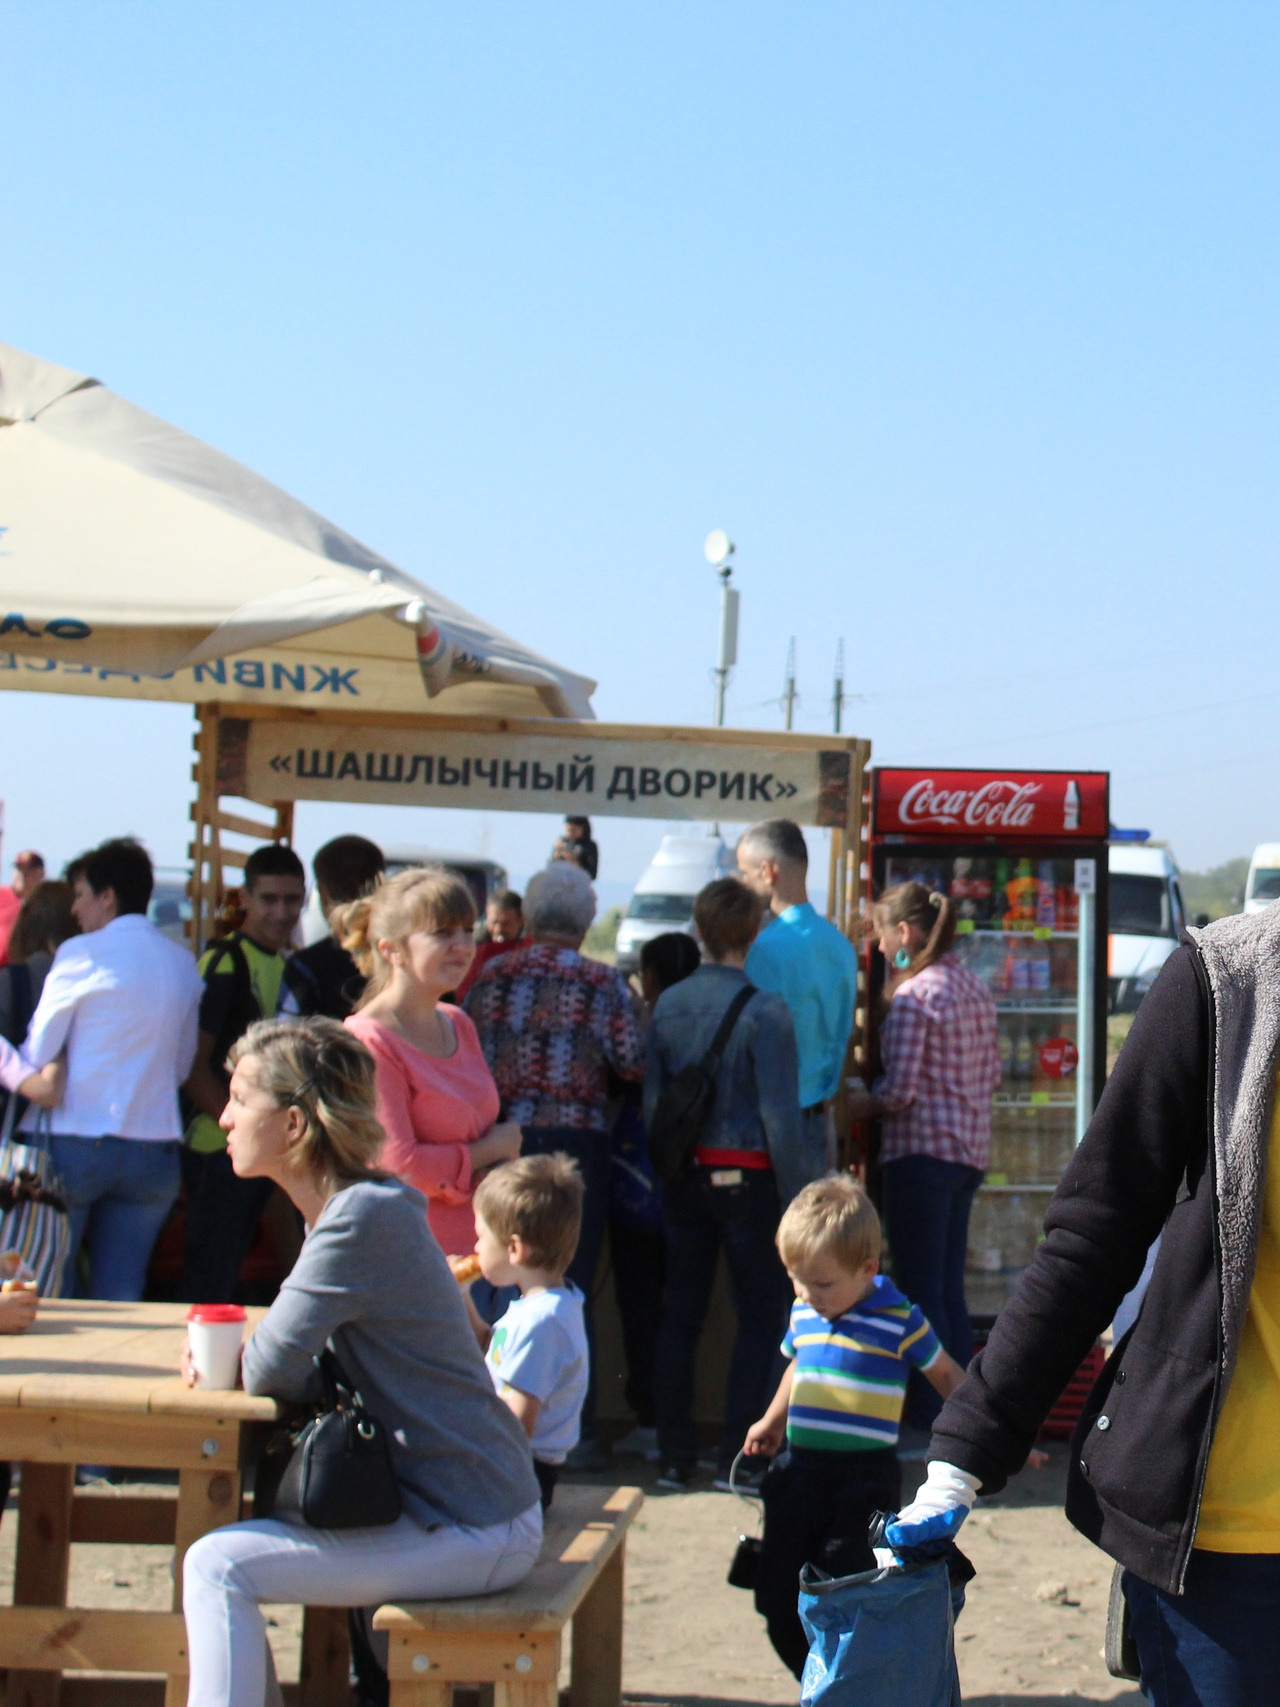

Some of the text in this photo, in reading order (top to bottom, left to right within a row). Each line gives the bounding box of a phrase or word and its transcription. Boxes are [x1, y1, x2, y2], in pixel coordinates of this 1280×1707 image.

[268, 748, 799, 802] «ШАШЛЫЧНЫЙ ДВОРИК»
[898, 778, 1044, 827] Coca-Cola
